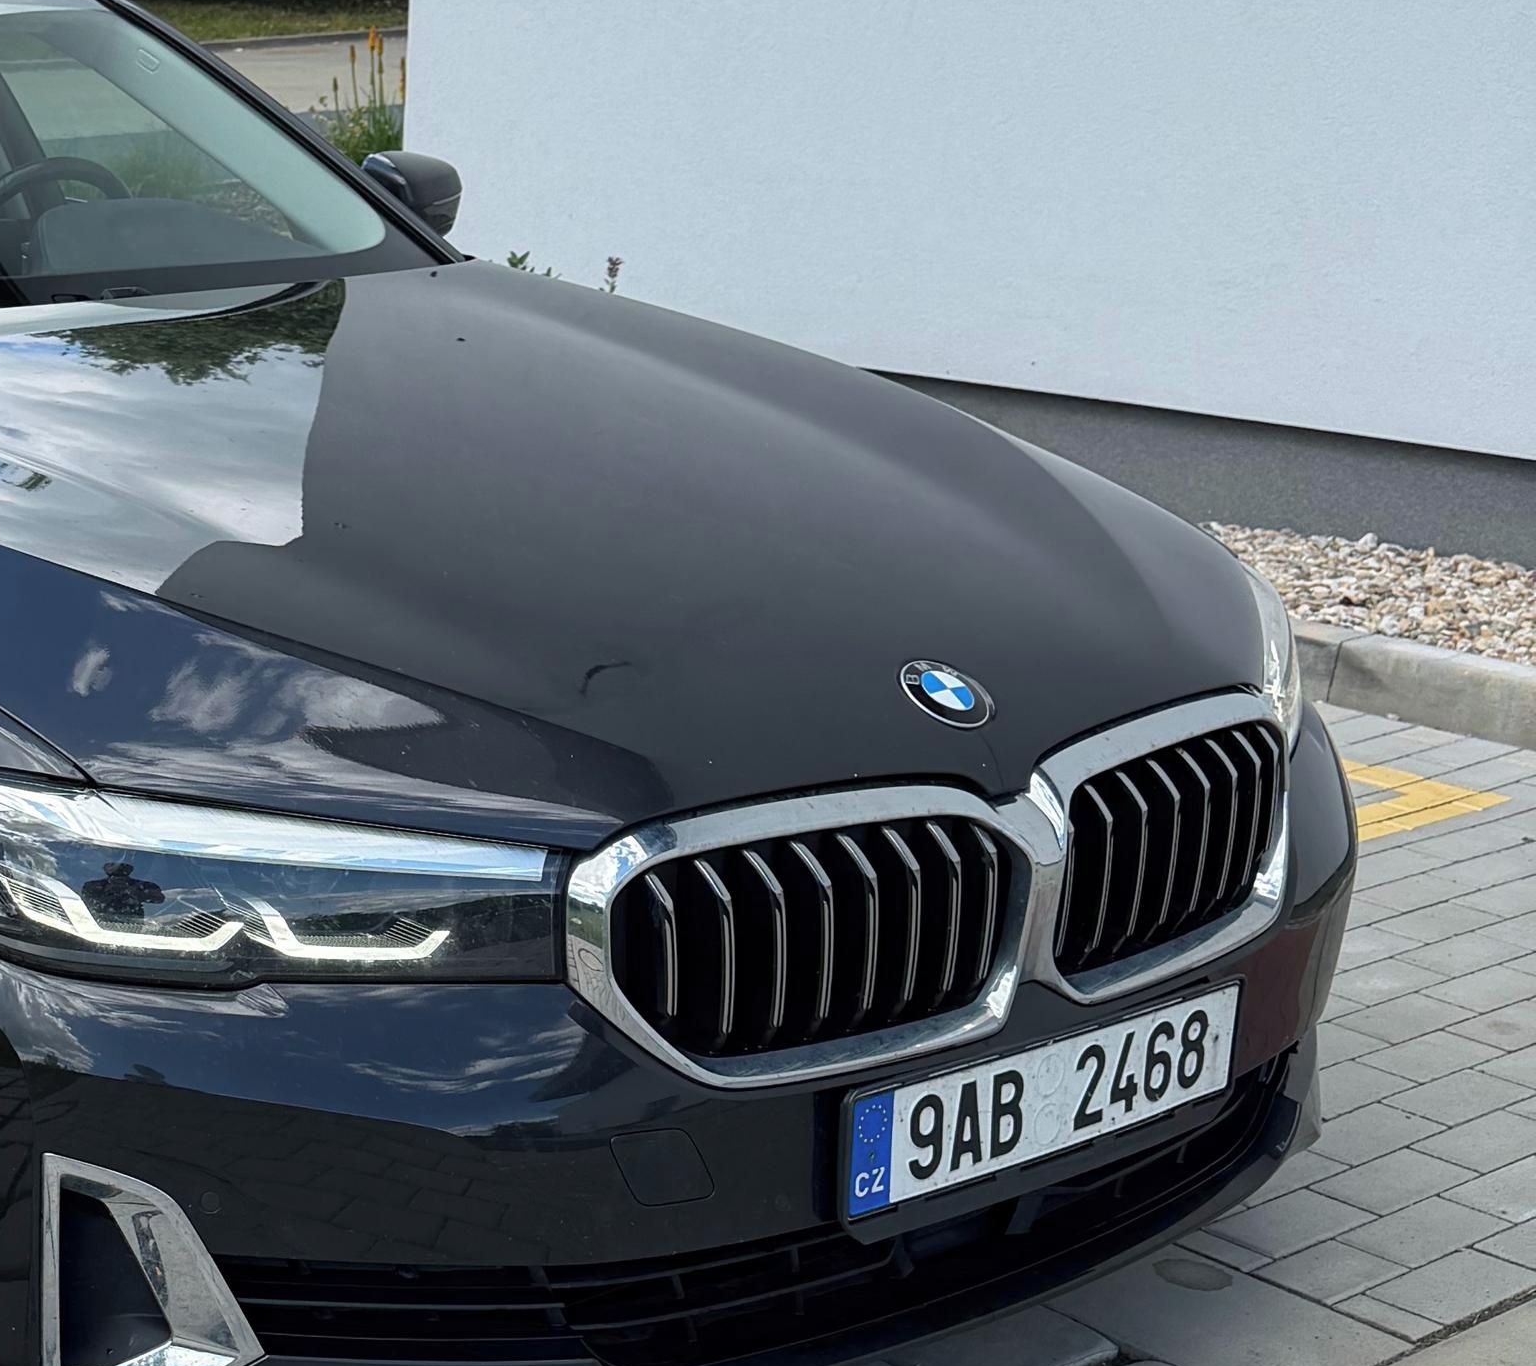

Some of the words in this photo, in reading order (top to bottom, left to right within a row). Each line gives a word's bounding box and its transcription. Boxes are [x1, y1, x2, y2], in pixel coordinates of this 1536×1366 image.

[908, 1069, 1023, 1180] 9AB
[1072, 1009, 1209, 1132] 2468
[854, 1166, 885, 1198] CZ
